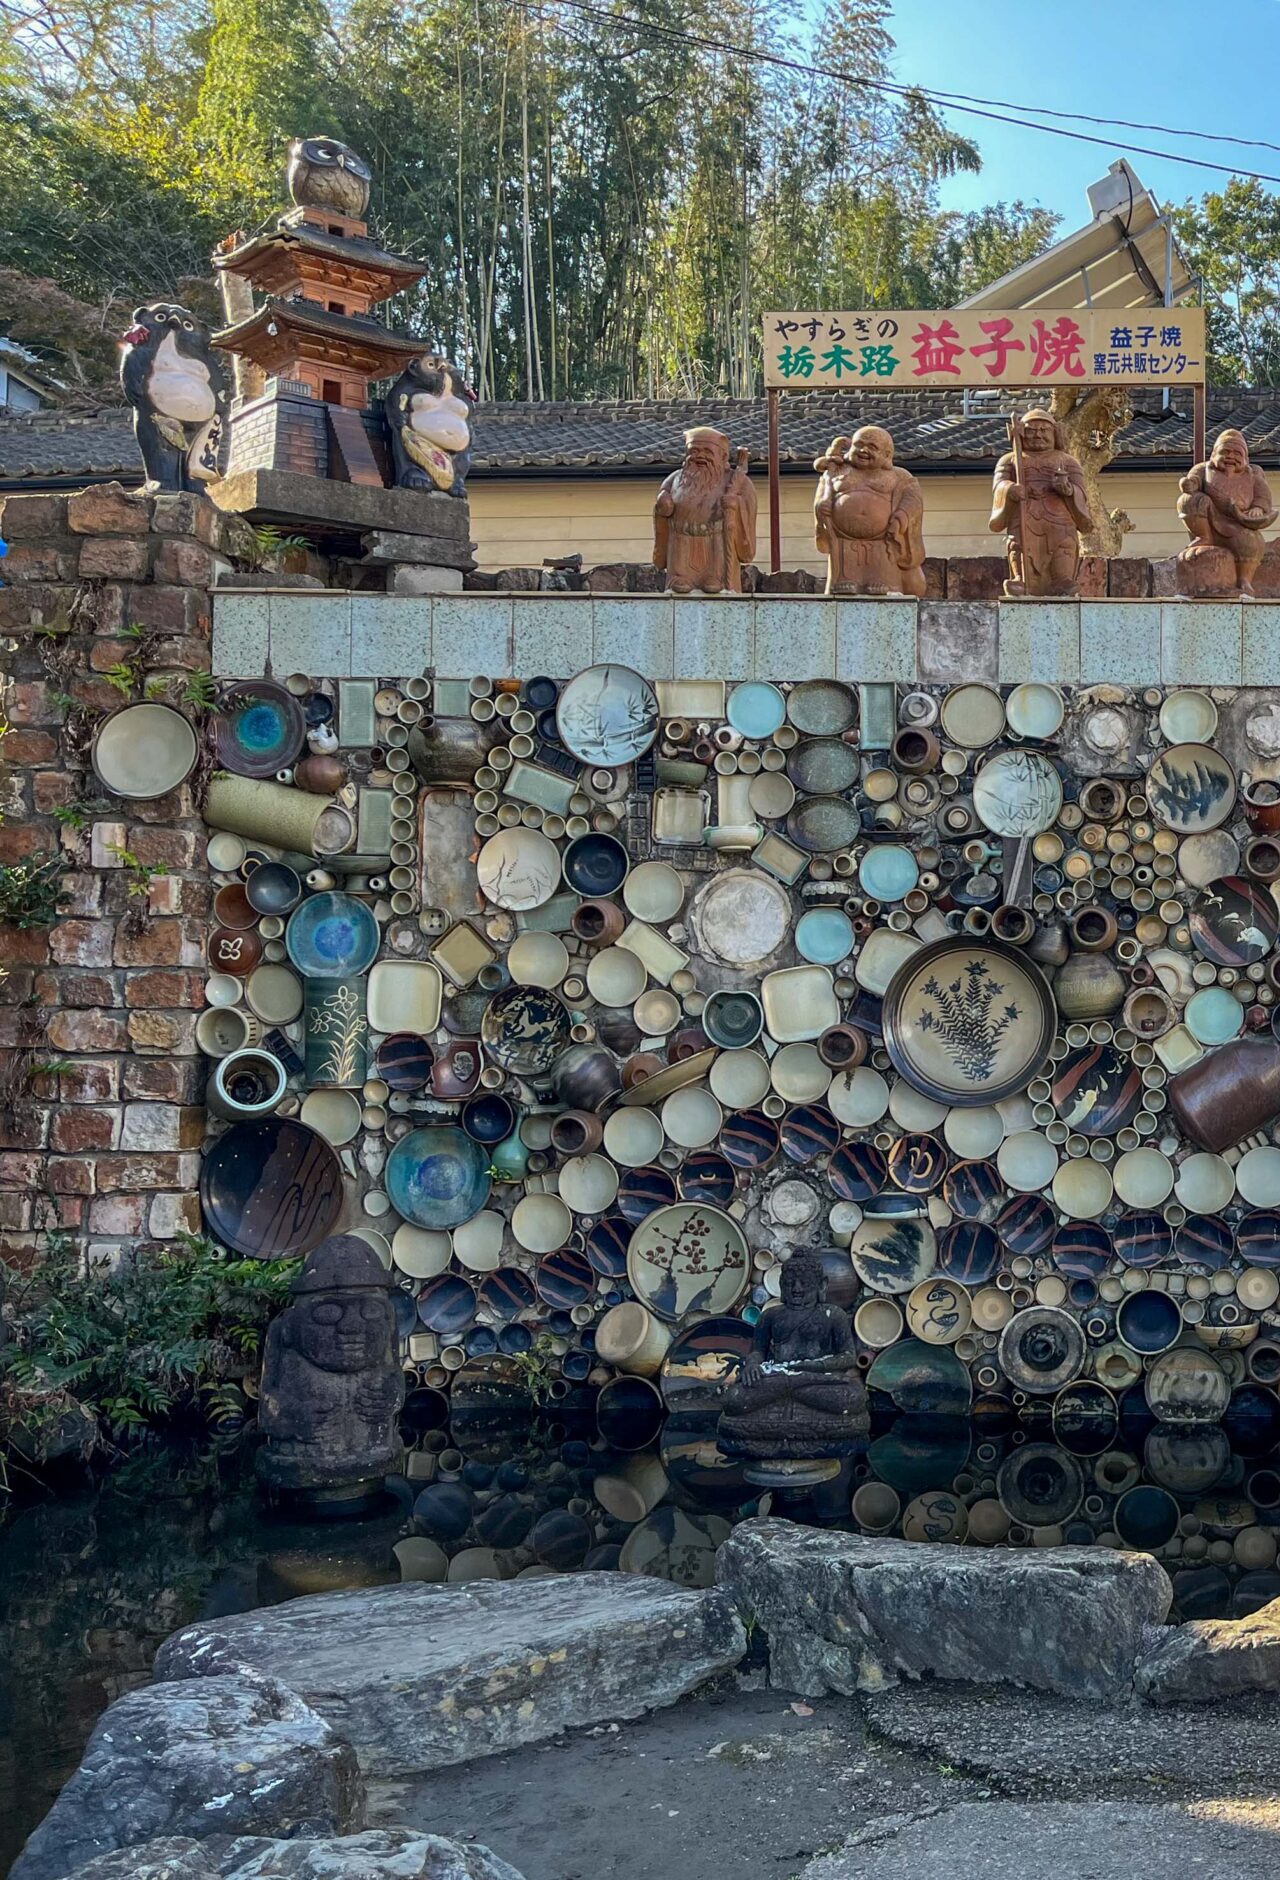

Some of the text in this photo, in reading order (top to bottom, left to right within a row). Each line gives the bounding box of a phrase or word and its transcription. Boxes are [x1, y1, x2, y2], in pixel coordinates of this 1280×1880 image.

[774, 317, 899, 342] やすらぎの
[1110, 326, 1183, 349] 益子焼
[911, 317, 1086, 377] 益子焼
[777, 344, 900, 379] 栃木路
[1093, 352, 1200, 375] 窯元共販センター
